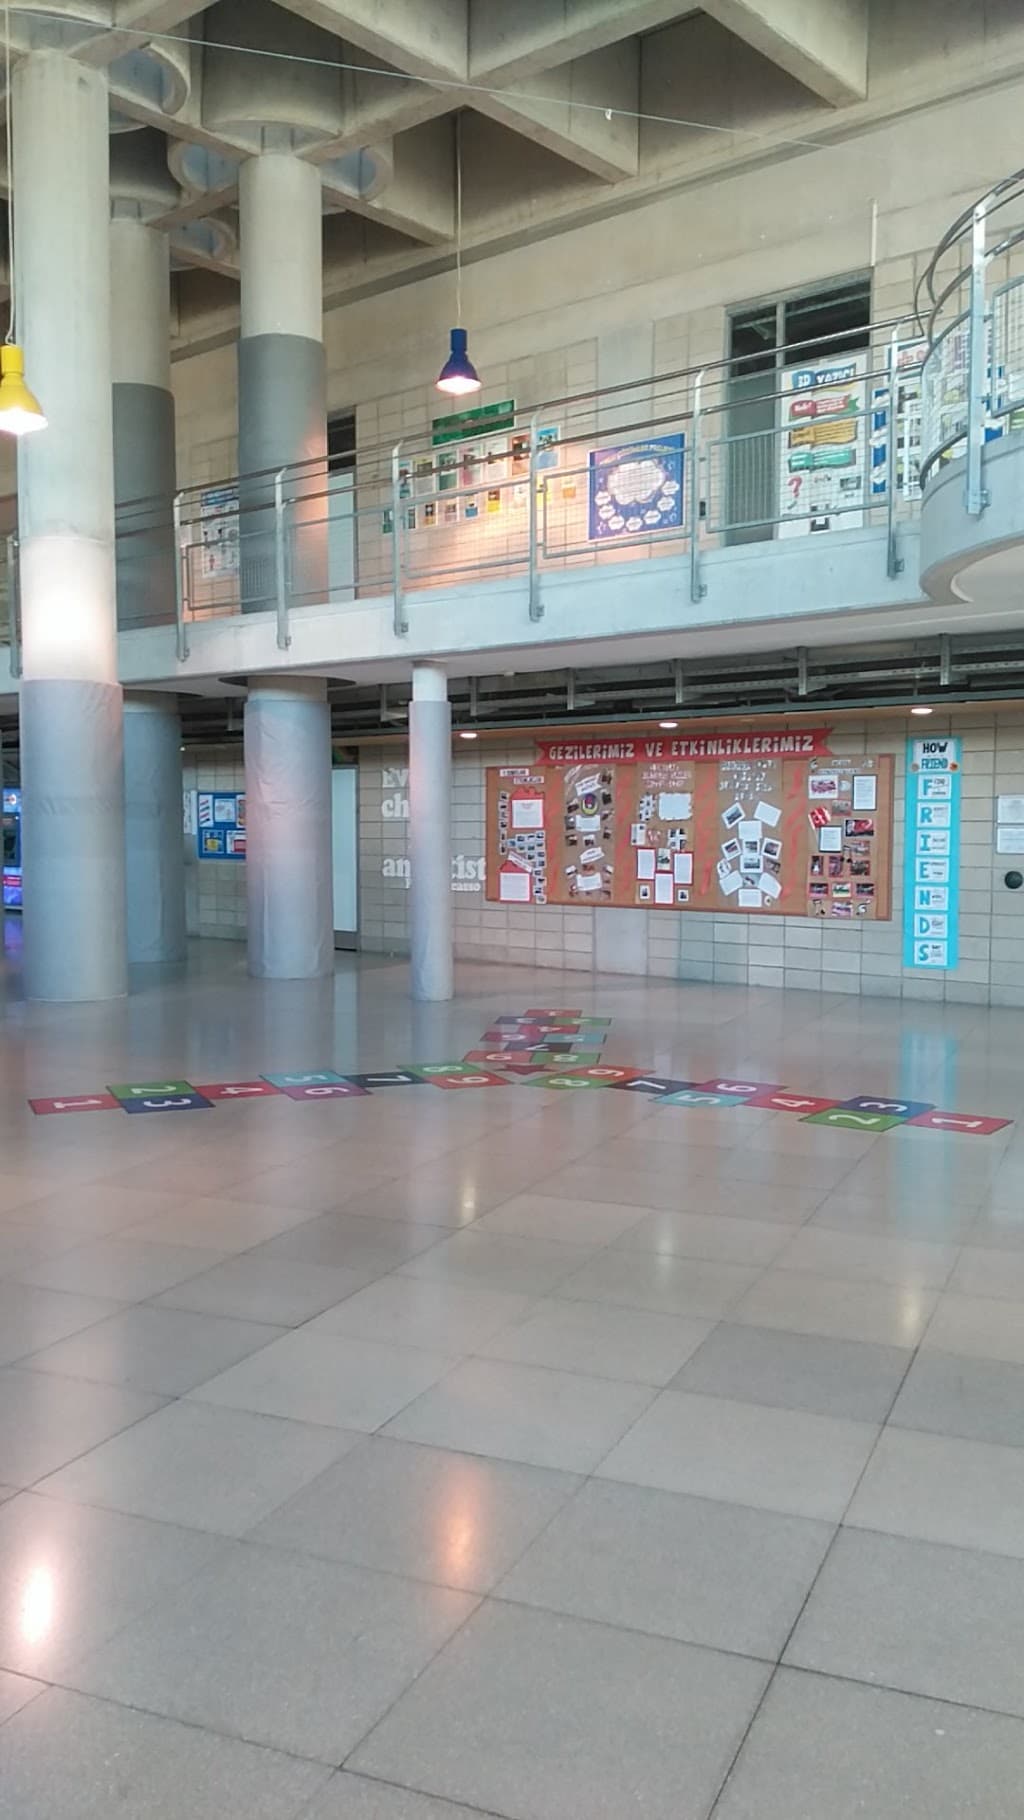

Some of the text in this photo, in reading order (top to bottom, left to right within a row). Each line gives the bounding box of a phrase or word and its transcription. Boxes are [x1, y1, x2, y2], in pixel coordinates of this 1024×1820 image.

[798, 374, 811, 388] 3D
[645, 742, 664, 757] VE
[922, 742, 948, 753] HOW
[921, 758, 948, 769] FRIEND
[382, 768, 410, 788] Ev
[381, 793, 410, 818] ch
[451, 855, 486, 881] ist
[53, 1099, 102, 1109] 1
[143, 1098, 192, 1108] 3
[860, 1101, 908, 1112] 3
[828, 1114, 881, 1125] 2
[931, 1117, 983, 1128] 1
